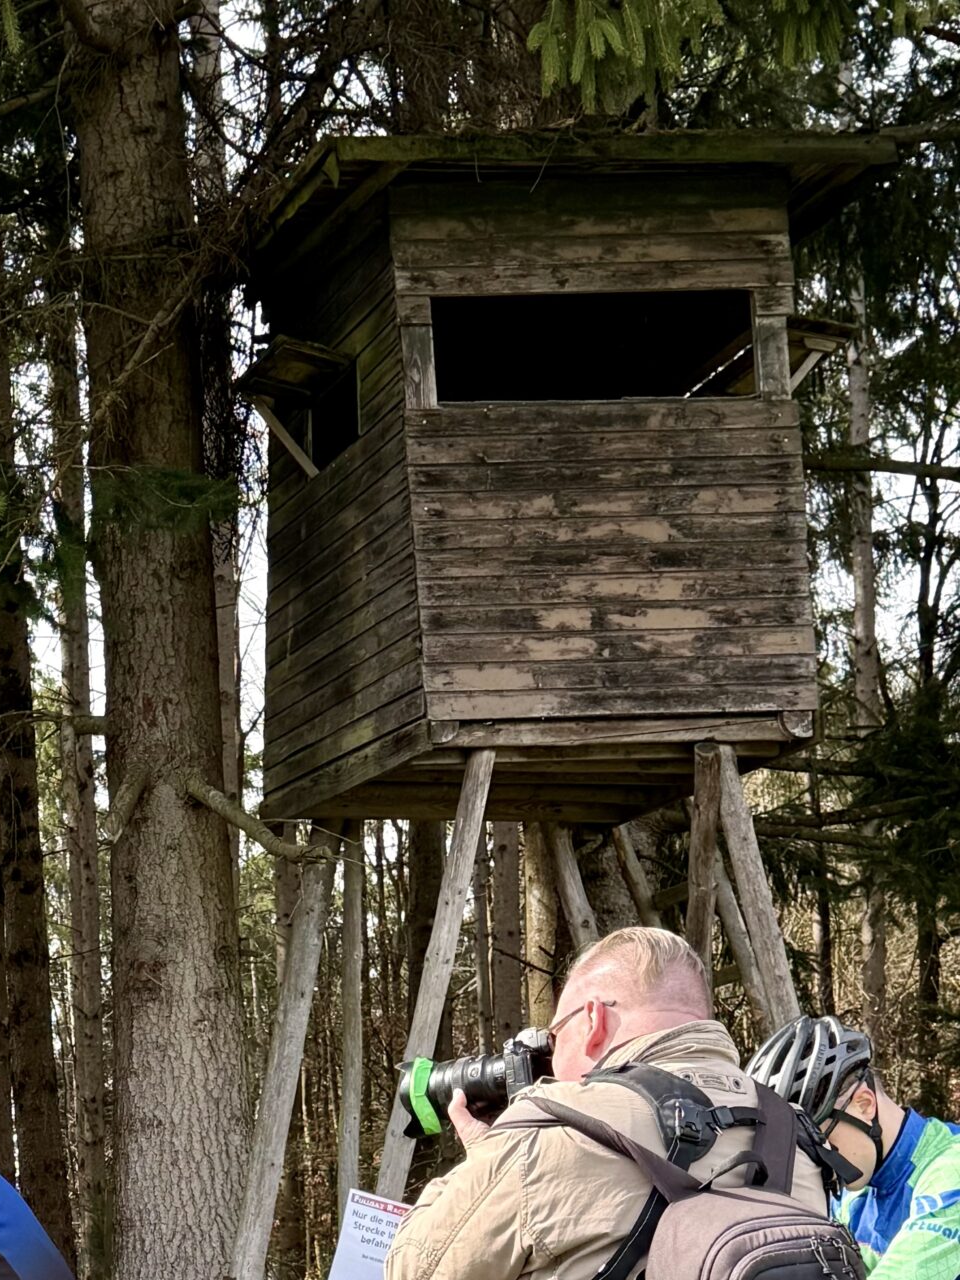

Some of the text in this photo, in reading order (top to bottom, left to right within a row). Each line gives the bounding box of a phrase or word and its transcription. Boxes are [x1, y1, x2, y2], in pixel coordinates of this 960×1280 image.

[352, 1209, 399, 1230] Nur die ma
[353, 1221, 386, 1238] Strecke
